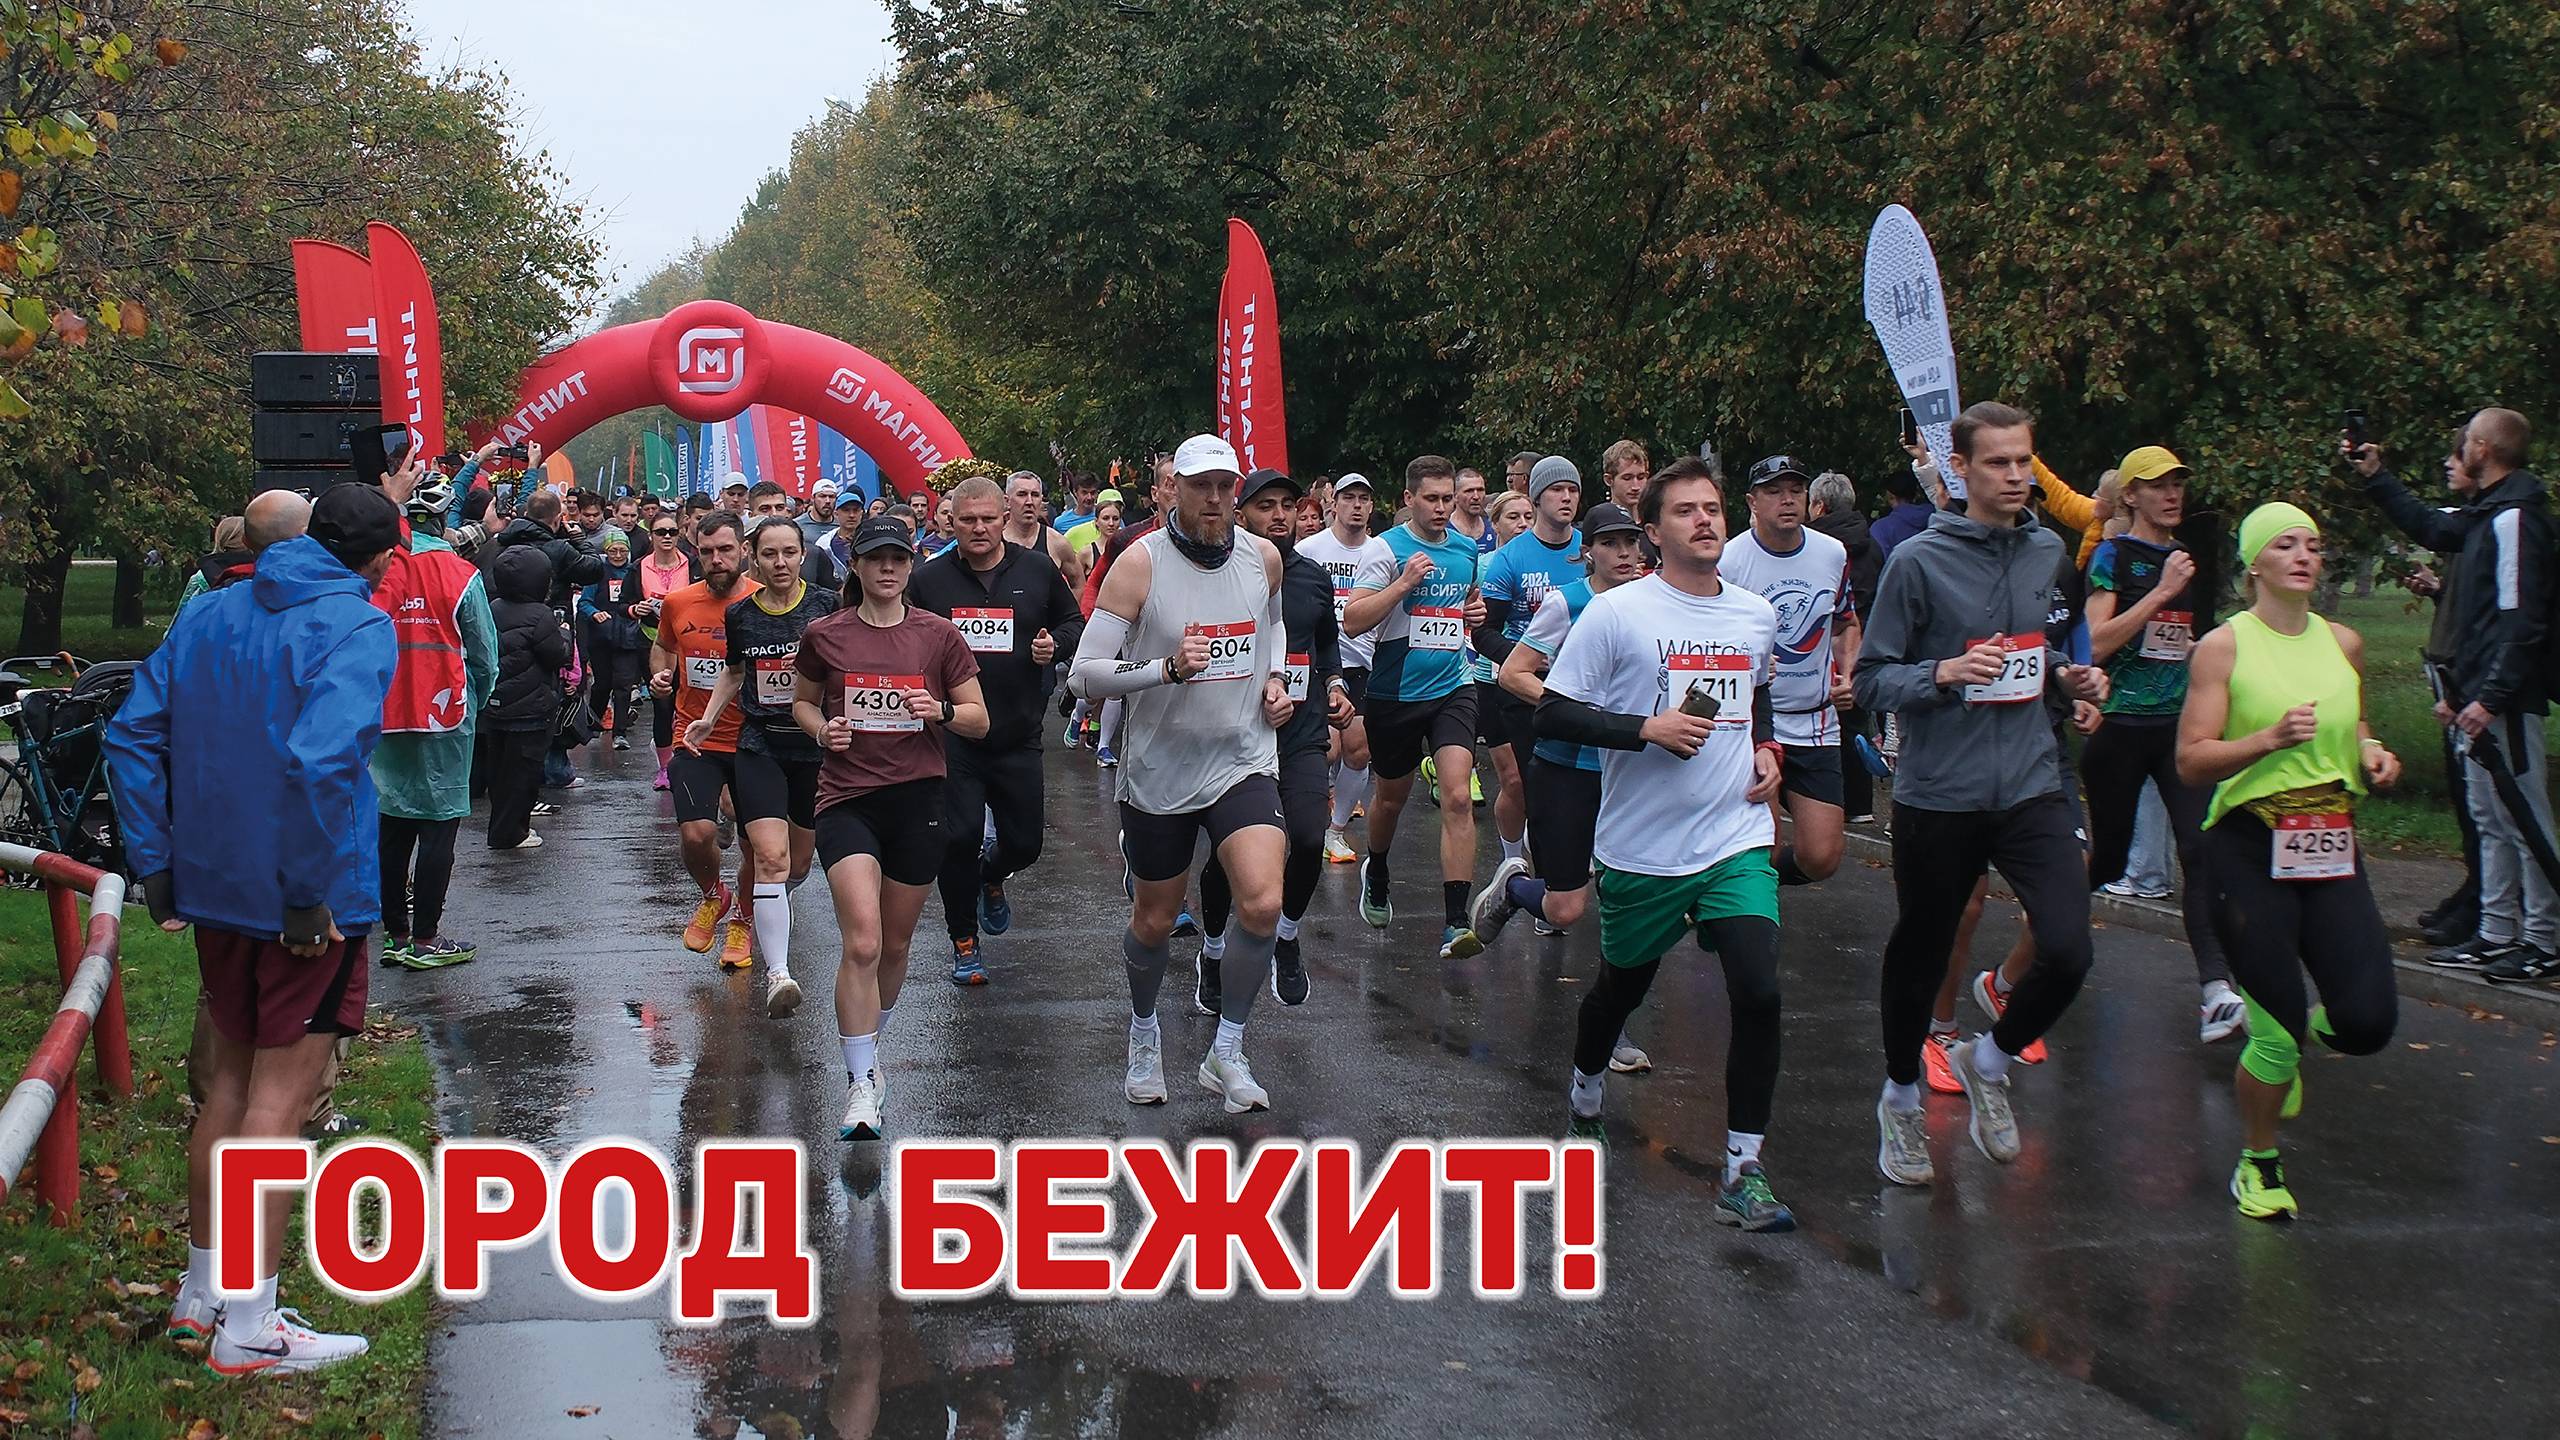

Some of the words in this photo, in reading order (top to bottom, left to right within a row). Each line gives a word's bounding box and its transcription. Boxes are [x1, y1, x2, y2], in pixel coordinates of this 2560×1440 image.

[1521, 571, 1550, 588] 2024
[1412, 588, 1428, 596] за
[958, 619, 1010, 635] 4084
[1419, 621, 1459, 637] 4172
[2284, 831, 2349, 855] 4263
